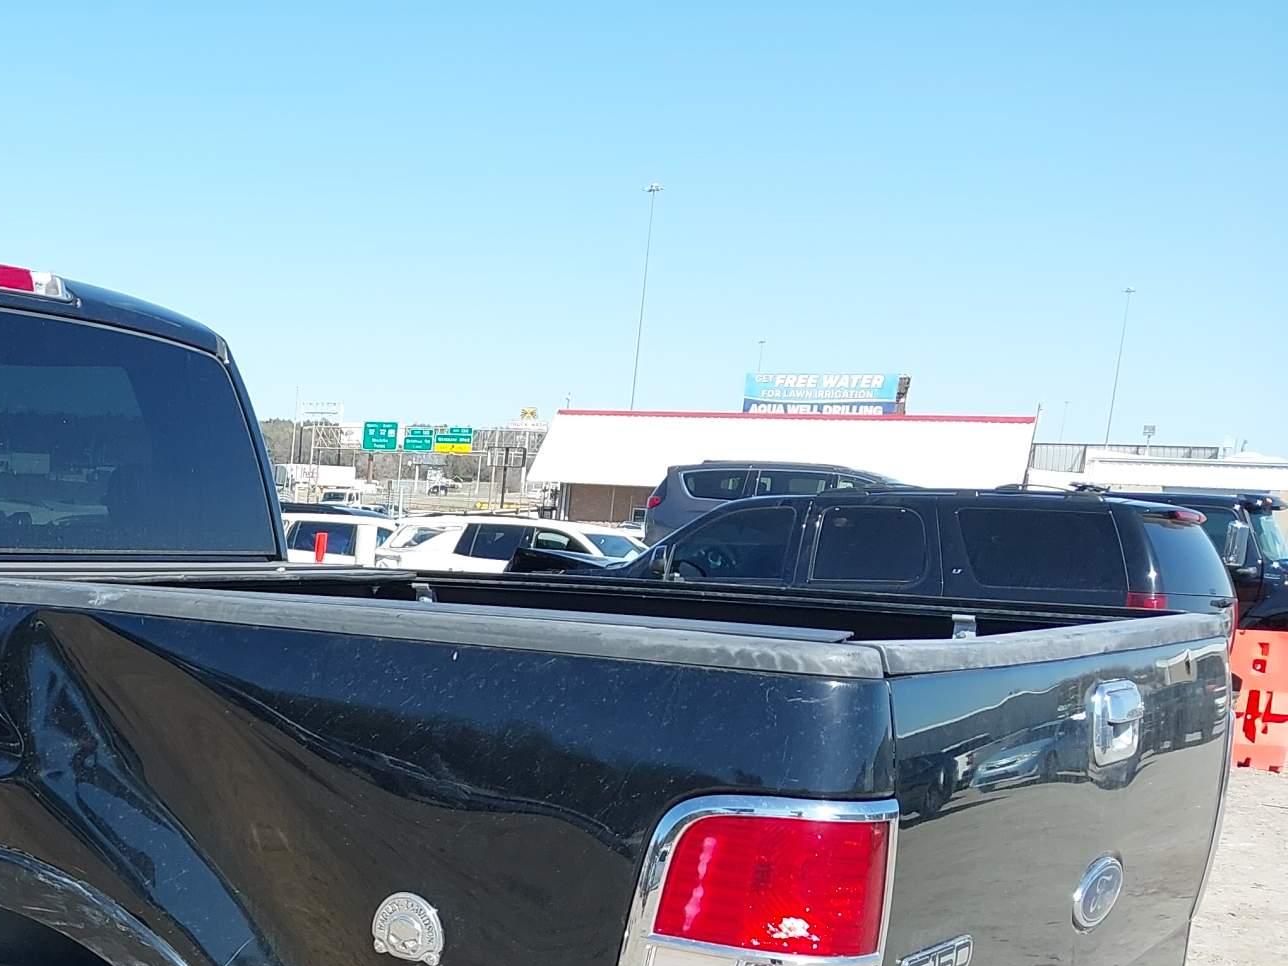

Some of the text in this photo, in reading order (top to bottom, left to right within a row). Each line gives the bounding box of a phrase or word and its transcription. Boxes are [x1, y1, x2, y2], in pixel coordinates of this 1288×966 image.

[774, 375, 821, 388] FREE
[822, 375, 884, 389] WATER
[761, 388, 874, 400] FOR LAWN IRRIGATION
[749, 404, 883, 415] AQUA WELL DRILLING
